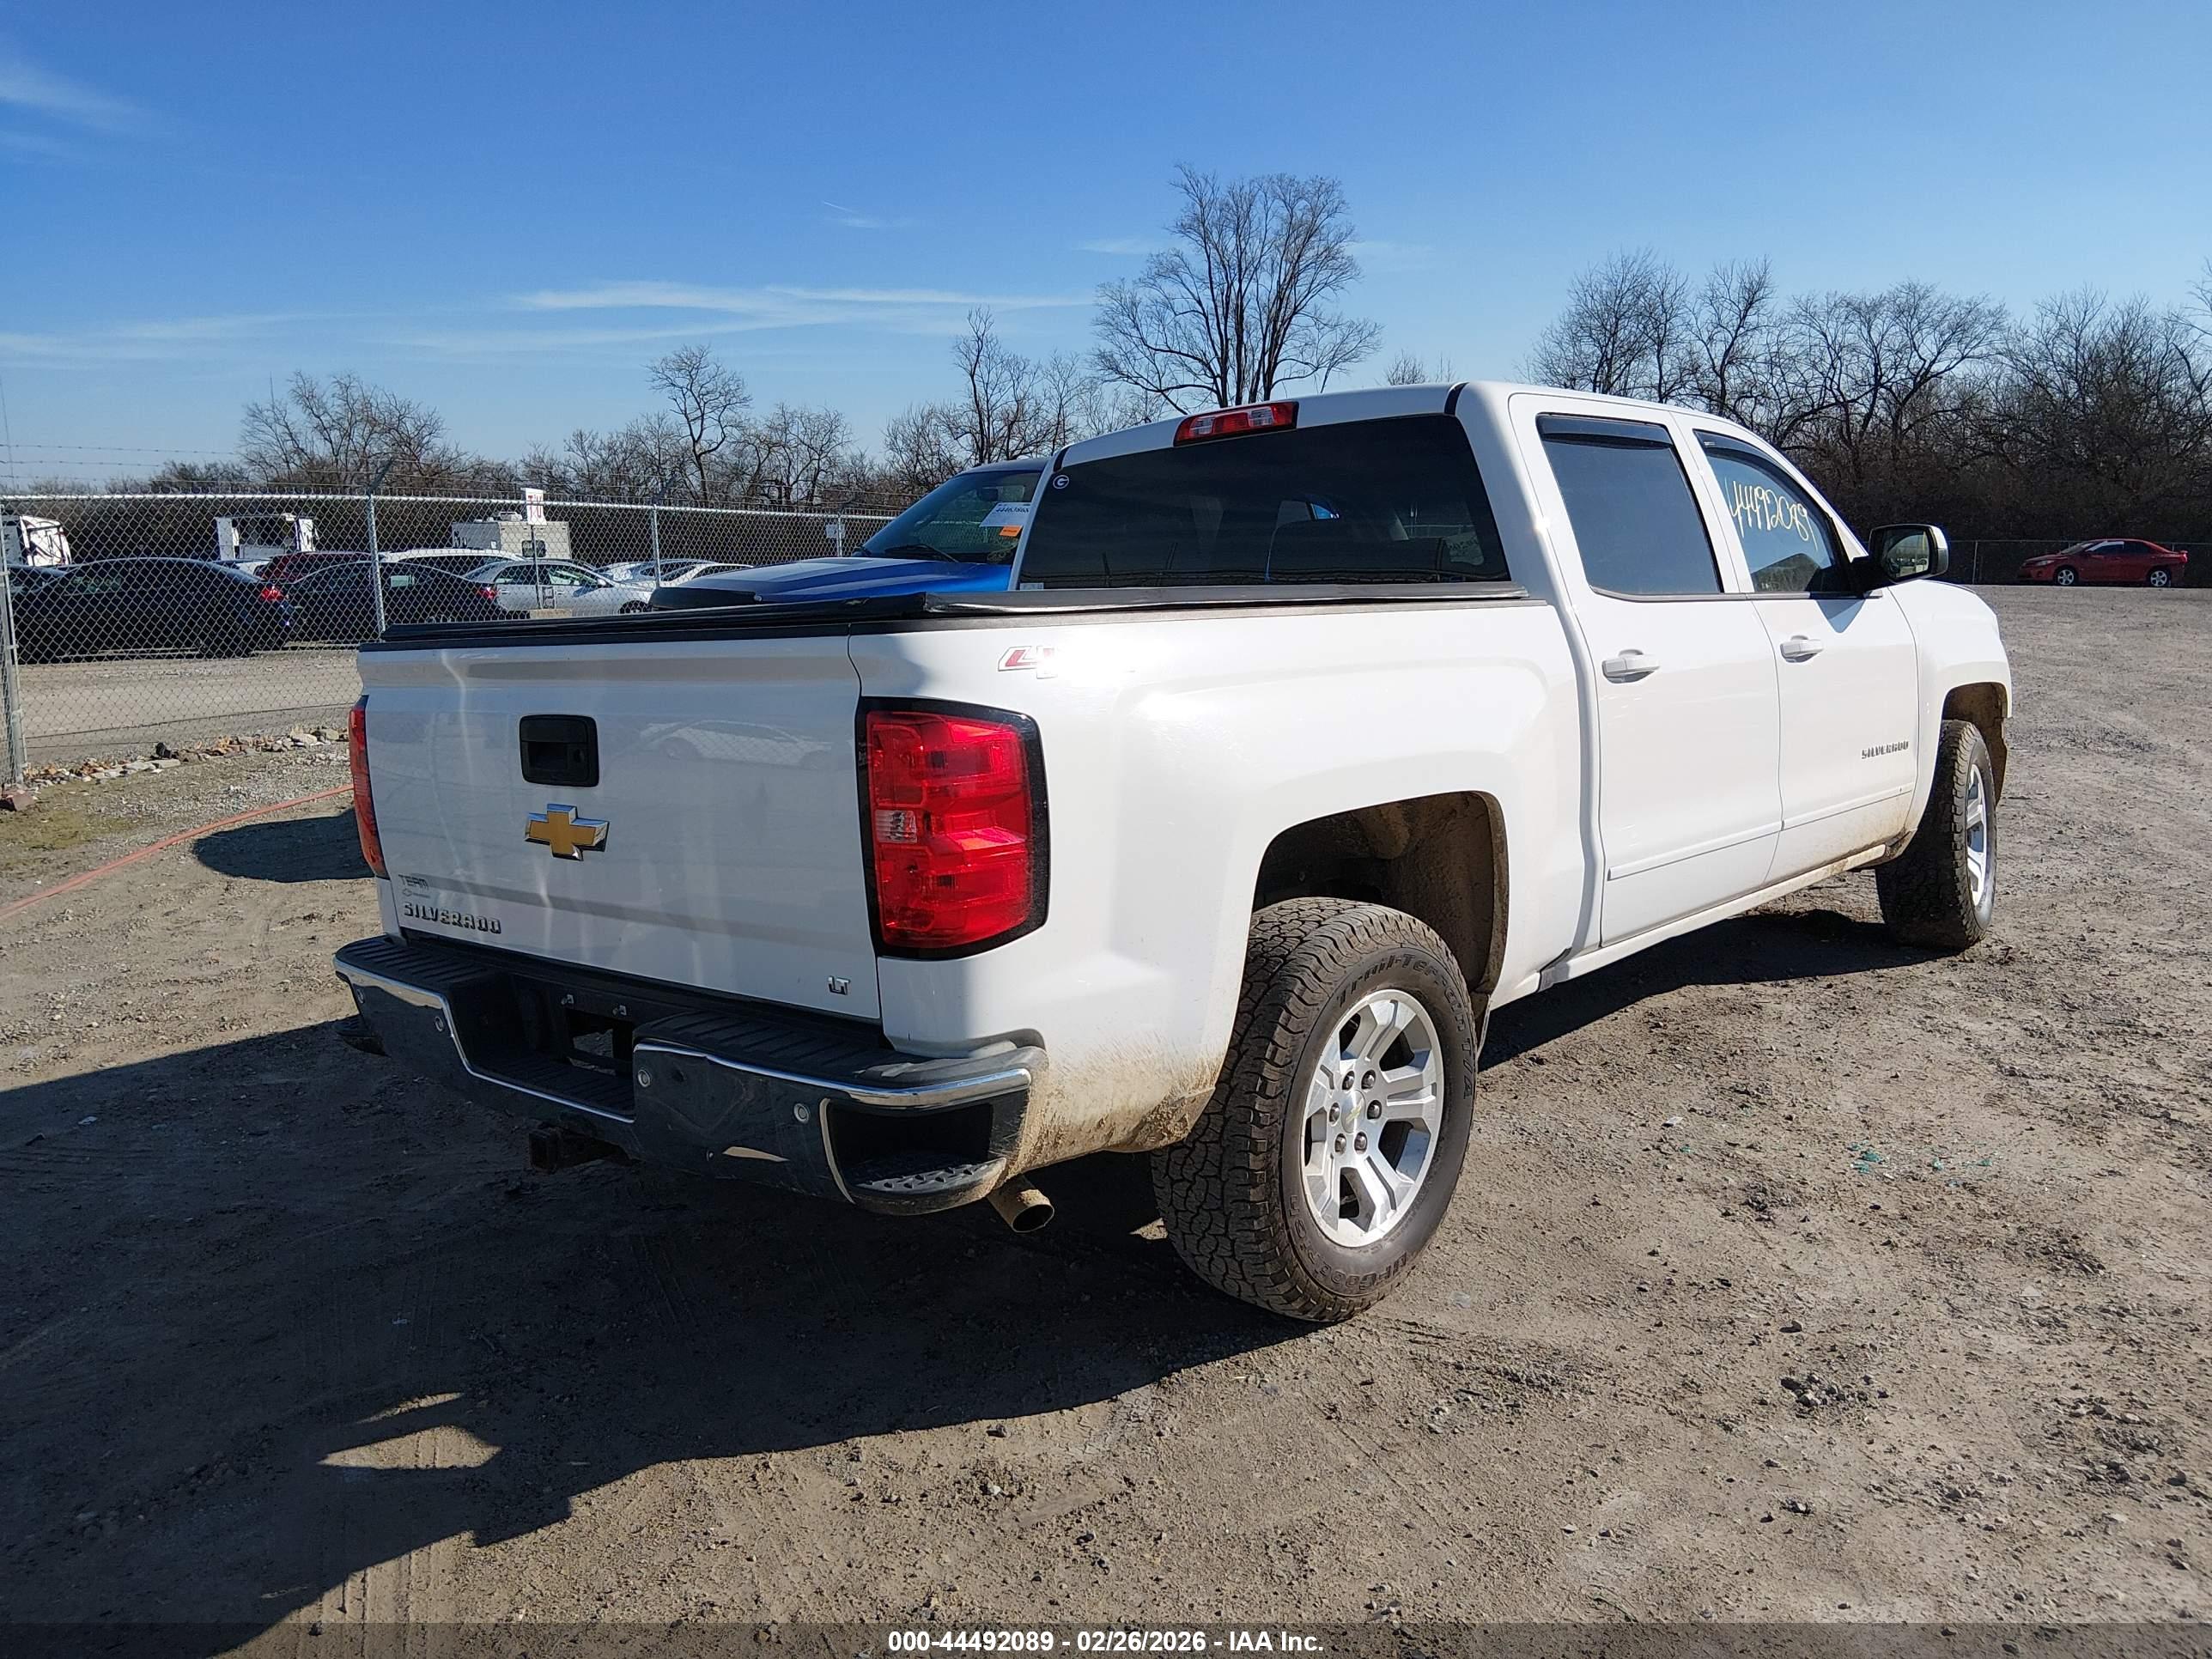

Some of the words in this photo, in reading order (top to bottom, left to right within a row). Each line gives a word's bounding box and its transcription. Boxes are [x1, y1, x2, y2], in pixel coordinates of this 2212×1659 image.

[1861, 740, 1909, 760] SILVERADO
[404, 902, 501, 934] SILVERADO
[828, 975, 851, 995] LT
